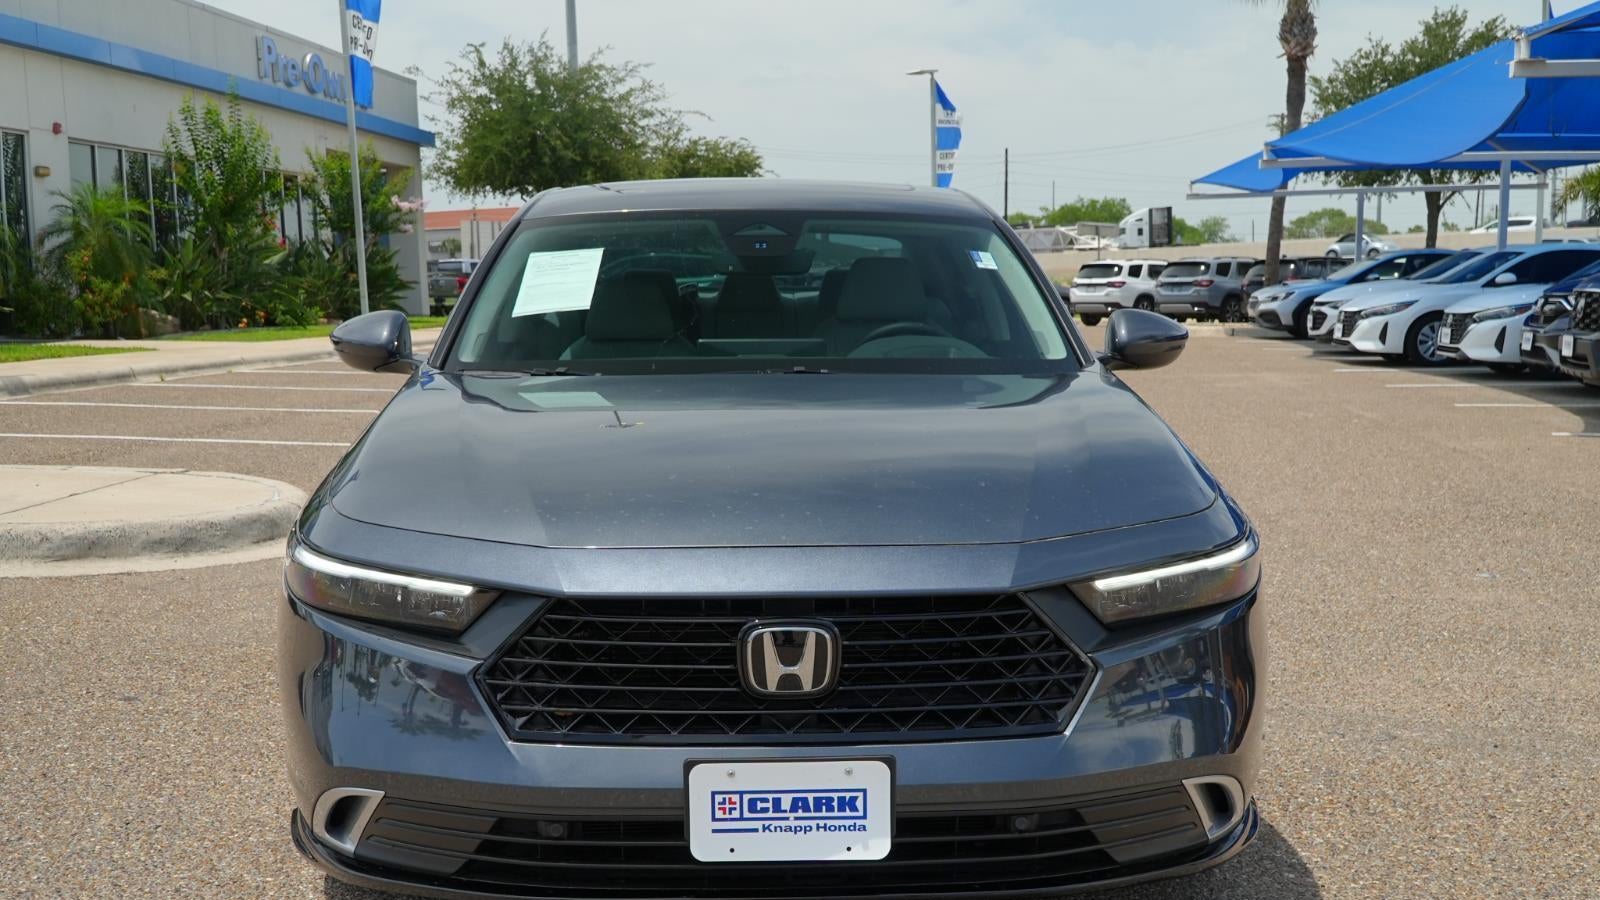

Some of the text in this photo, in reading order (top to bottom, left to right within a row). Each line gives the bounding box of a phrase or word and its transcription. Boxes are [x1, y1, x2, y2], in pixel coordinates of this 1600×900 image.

[747, 795, 860, 814] CLARK
[762, 822, 867, 835] Knapp Honda
